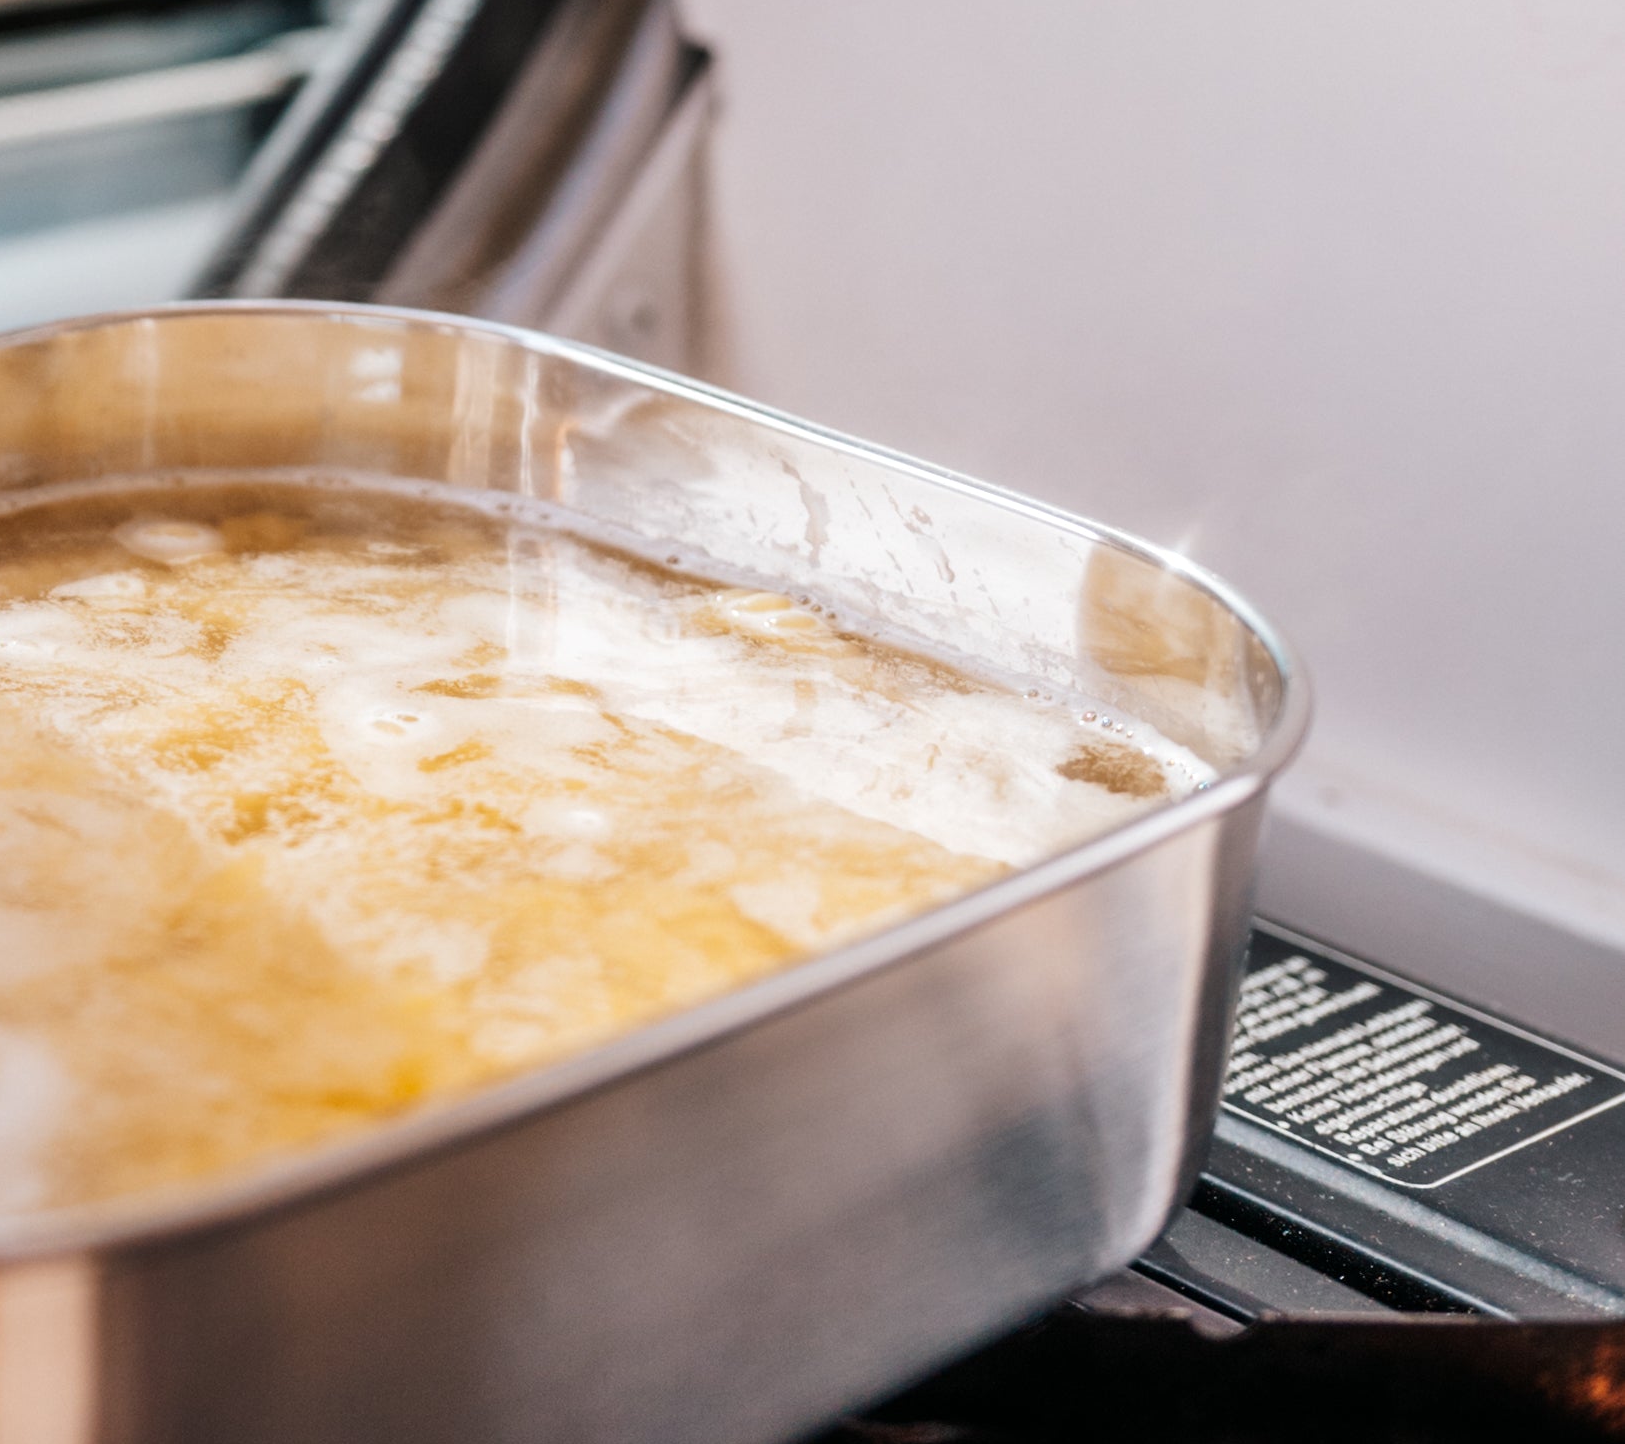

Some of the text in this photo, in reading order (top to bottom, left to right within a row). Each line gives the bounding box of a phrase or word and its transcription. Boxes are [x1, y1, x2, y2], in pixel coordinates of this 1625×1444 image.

[1286, 1099, 1341, 1124] Keine
[1333, 1098, 1439, 1145] Reparaturen
[1358, 1136, 1394, 1155] Bei
[1385, 1111, 1458, 1143] Störung
[1387, 1147, 1426, 1167] sich
[1416, 1131, 1460, 1152] bitte
[1454, 1122, 1482, 1137] an
